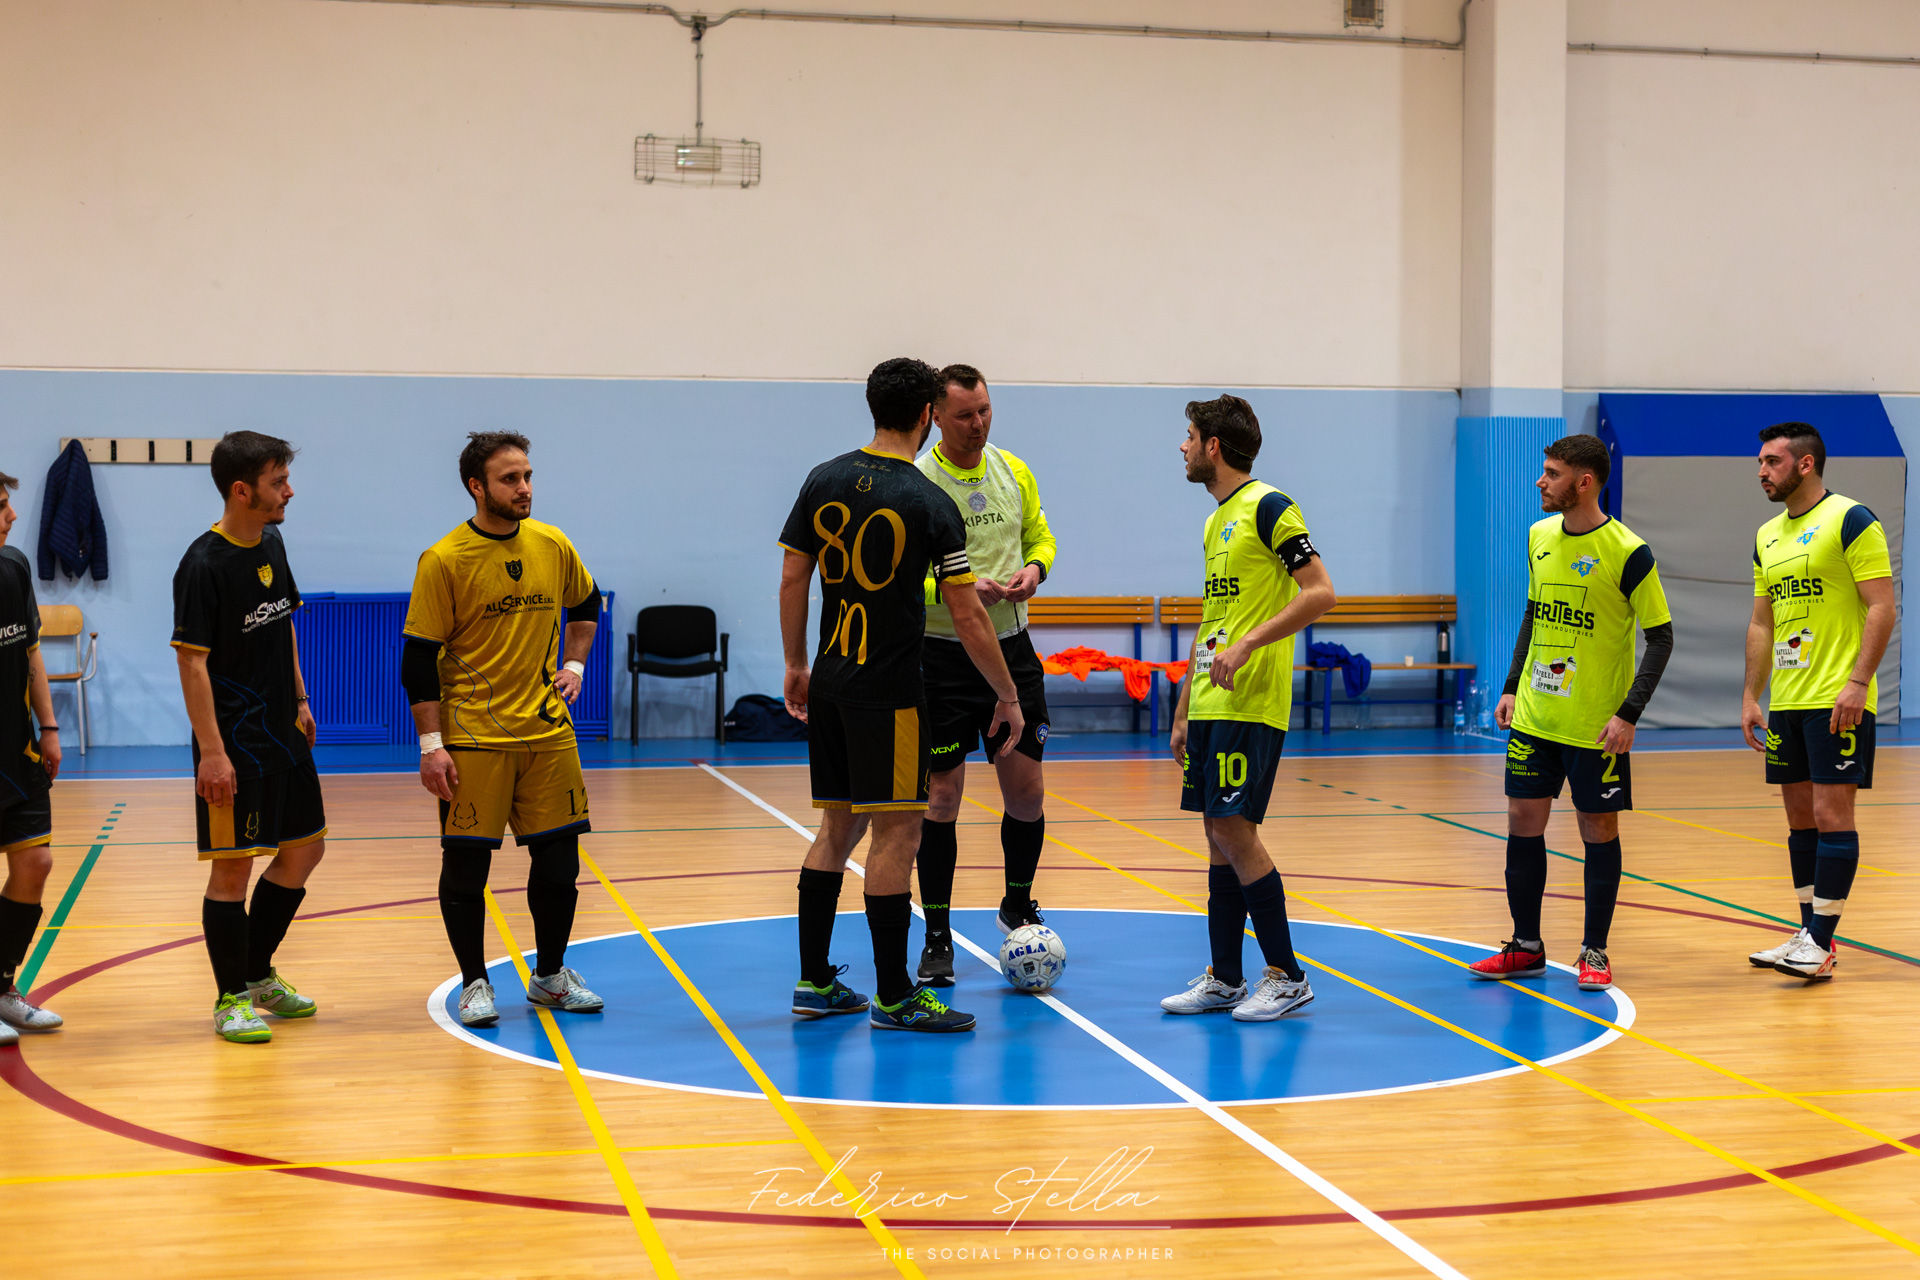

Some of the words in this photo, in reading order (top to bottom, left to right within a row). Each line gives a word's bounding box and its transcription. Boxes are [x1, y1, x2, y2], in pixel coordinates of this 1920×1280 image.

[964, 512, 1005, 528] KIPSTA
[813, 501, 907, 592] 80
[1551, 625, 1594, 638] INDUSTRIES
[930, 742, 960, 755] VOVA
[1840, 724, 1857, 757] 5
[1216, 752, 1248, 788] 10
[1600, 751, 1620, 783] 2
[565, 786, 589, 816] 12
[1008, 942, 1048, 961] AGLA
